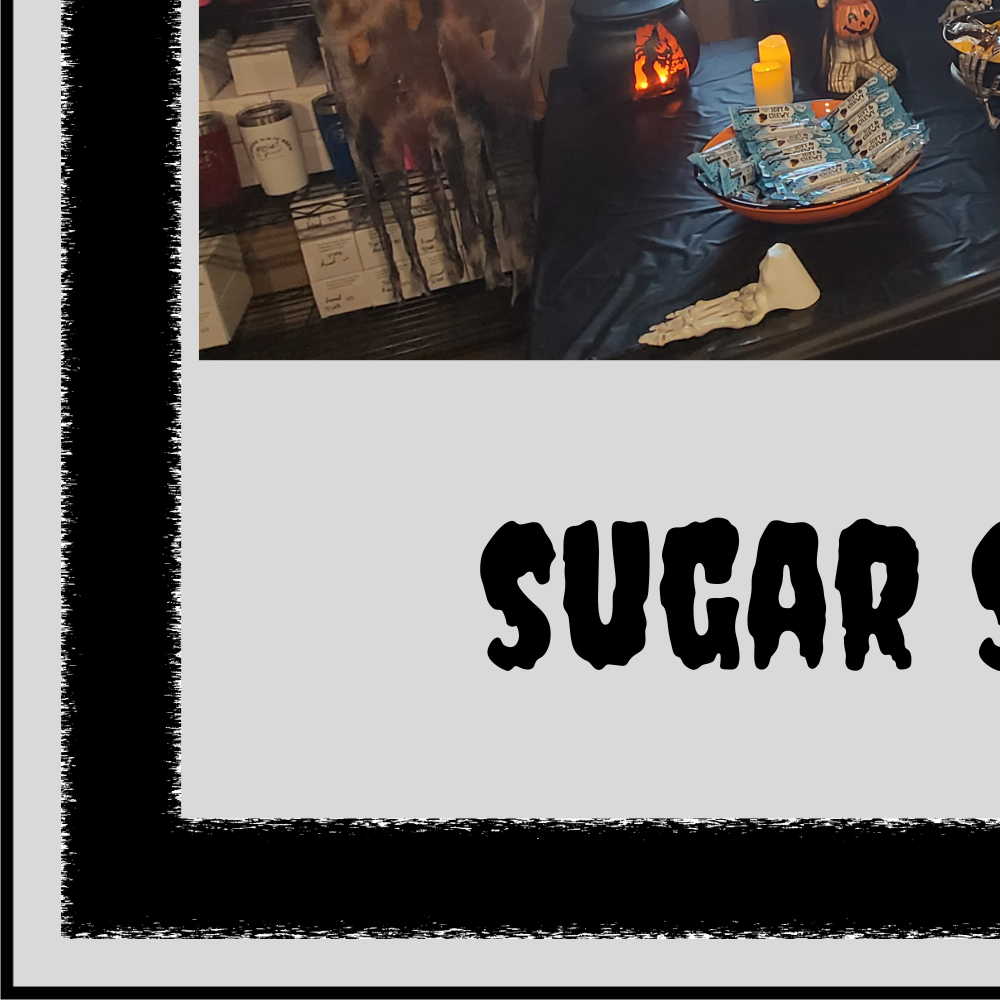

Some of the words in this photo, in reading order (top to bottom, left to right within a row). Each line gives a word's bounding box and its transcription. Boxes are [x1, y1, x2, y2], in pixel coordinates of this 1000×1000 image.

[847, 93, 865, 110] CHEWY
[857, 107, 869, 119] SOFT
[857, 108, 876, 126] CHEWY
[868, 135, 888, 152] CHEWY
